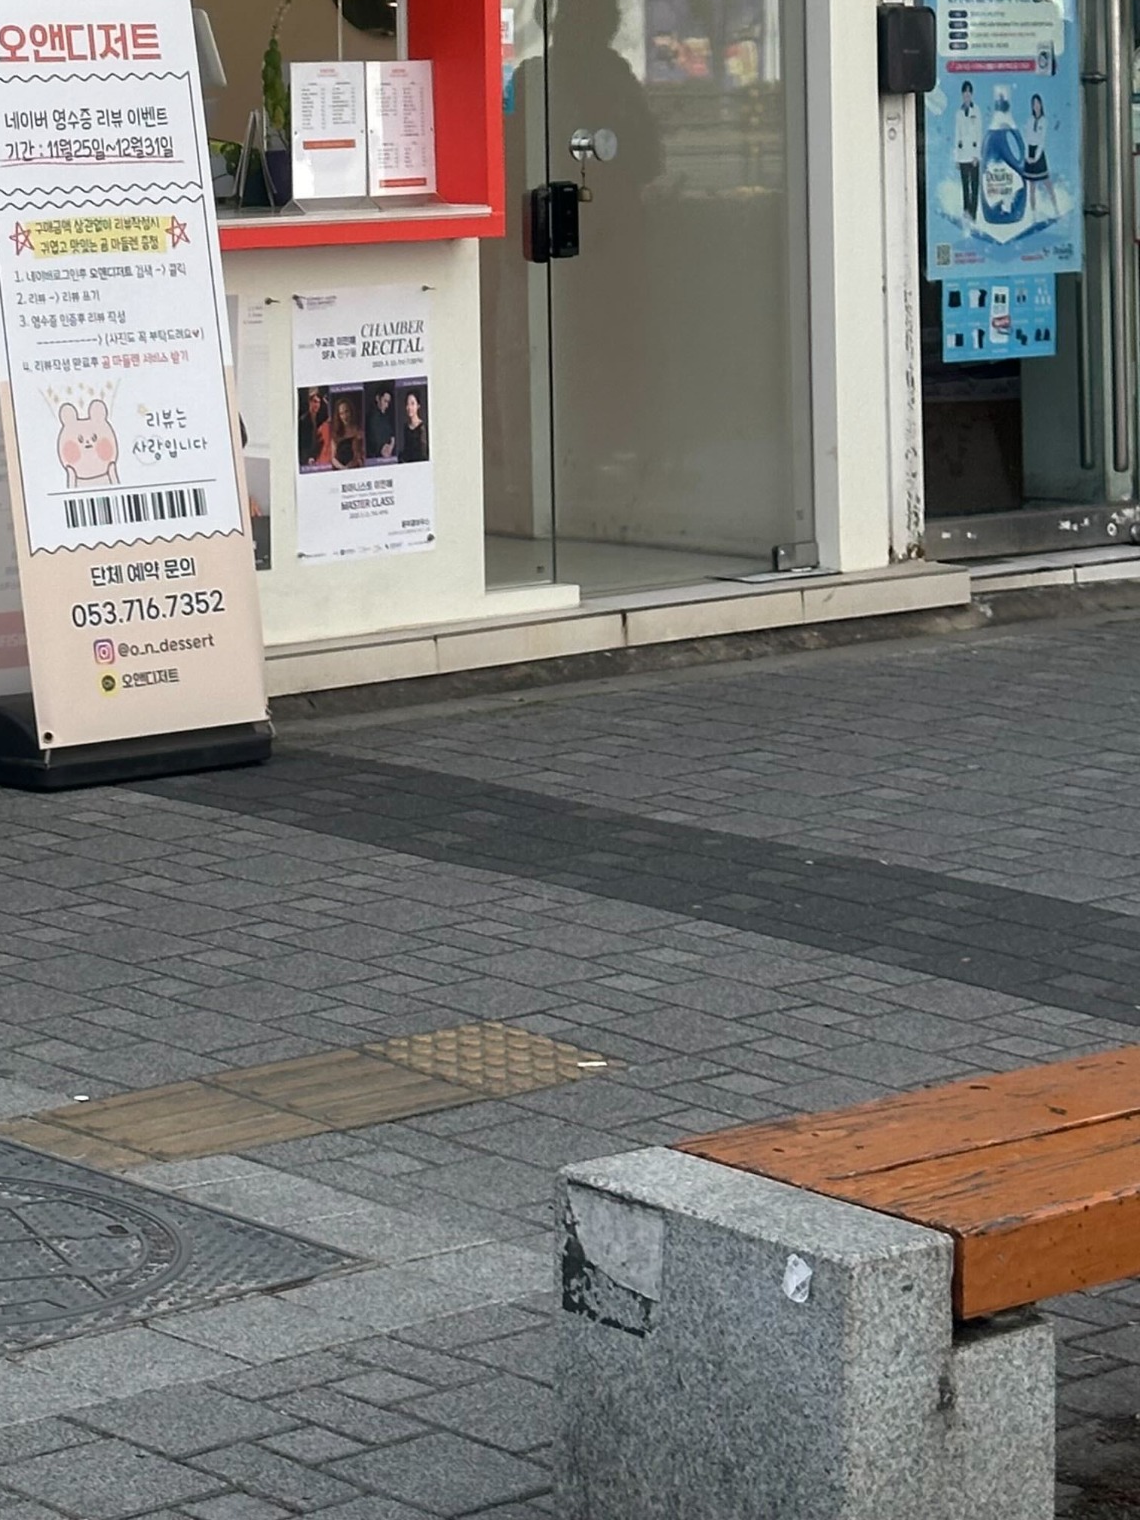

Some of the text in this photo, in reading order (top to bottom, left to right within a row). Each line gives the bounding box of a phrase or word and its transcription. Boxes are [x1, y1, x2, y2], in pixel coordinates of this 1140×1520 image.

[4, 106, 169, 131] 네이버 영수증 리뷰 이벤트
[5, 140, 35, 160] 기간
[35, 216, 160, 235] 구매금액 상관없이 리뷰작성시
[16, 292, 27, 305] 2.
[360, 319, 425, 338] CHAMBER
[360, 337, 425, 357] RECITAL
[145, 408, 187, 428] 리뷰는
[132, 437, 209, 460] 사랑입니다
[90, 557, 197, 587] 단체 예약 문의
[72, 590, 226, 628] 053.716.7352
[122, 668, 181, 689] 오앤디저트
